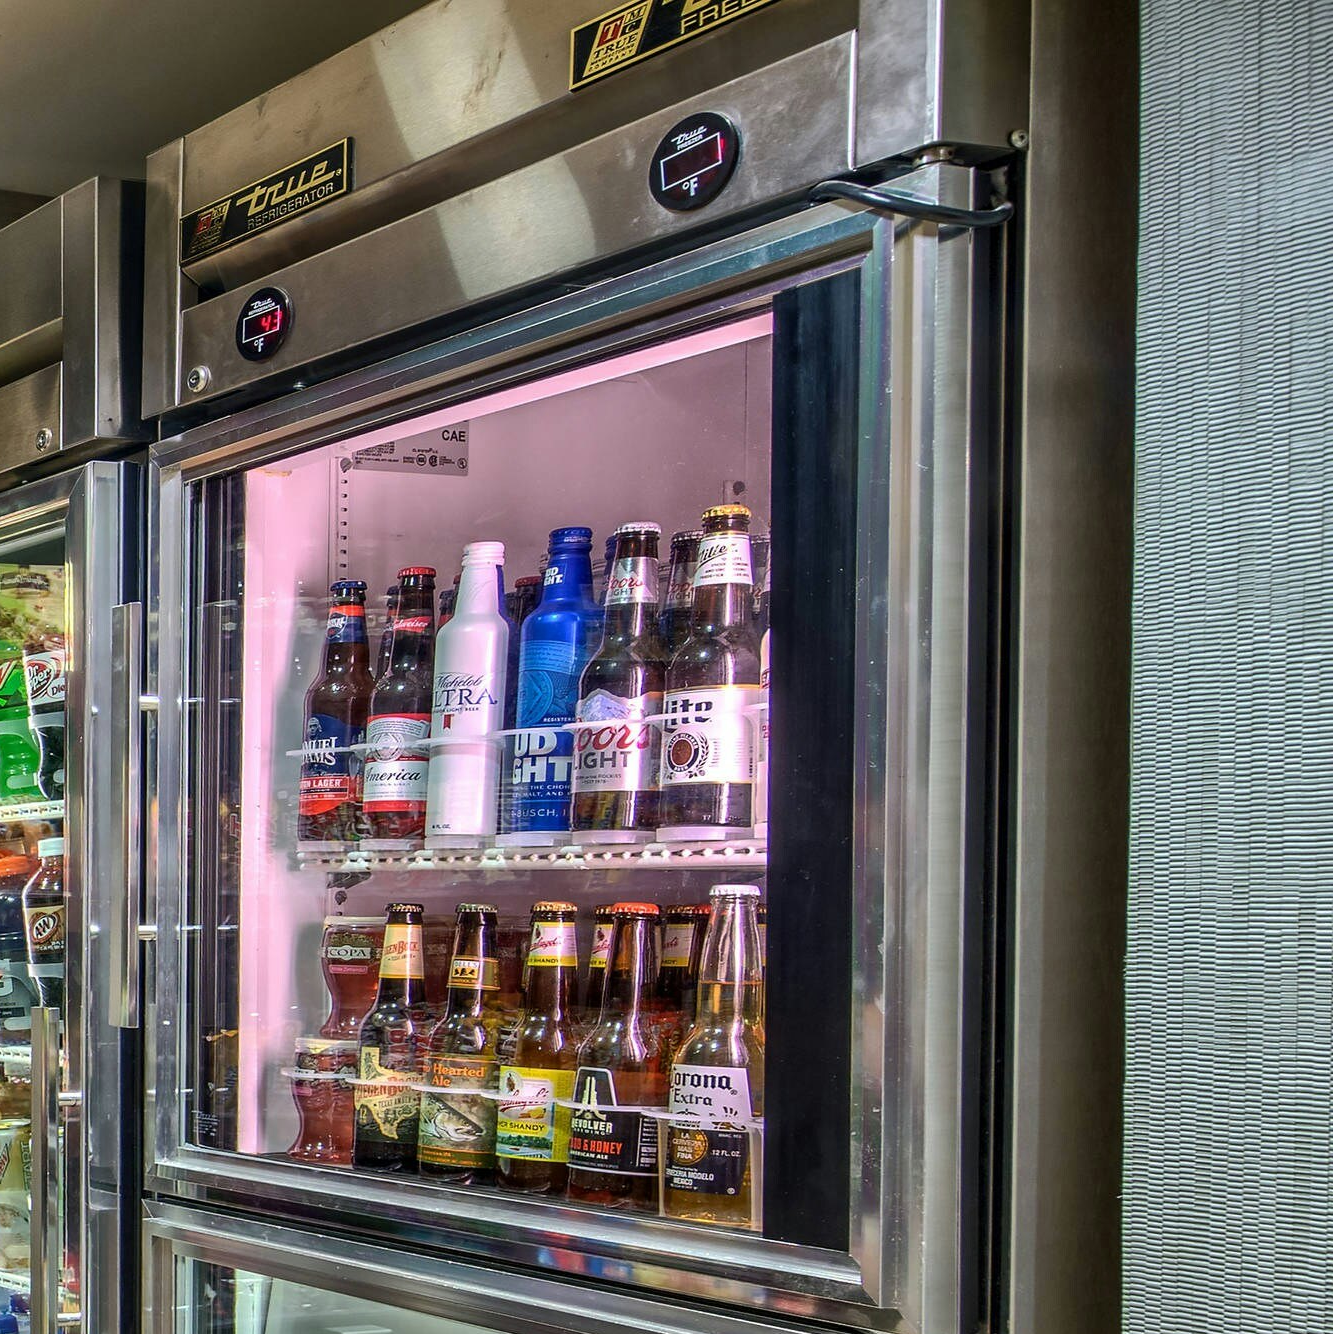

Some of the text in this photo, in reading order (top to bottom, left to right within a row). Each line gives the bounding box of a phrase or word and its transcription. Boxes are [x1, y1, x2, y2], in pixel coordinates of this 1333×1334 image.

[248, 182, 334, 230] REFRIGERATOR
[329, 947, 367, 957] COPA
[434, 1064, 485, 1078] Hearted
[674, 1088, 713, 1106] Extra
[510, 1122, 545, 1131] SHANDY
[590, 1141, 623, 1154] HONEY
